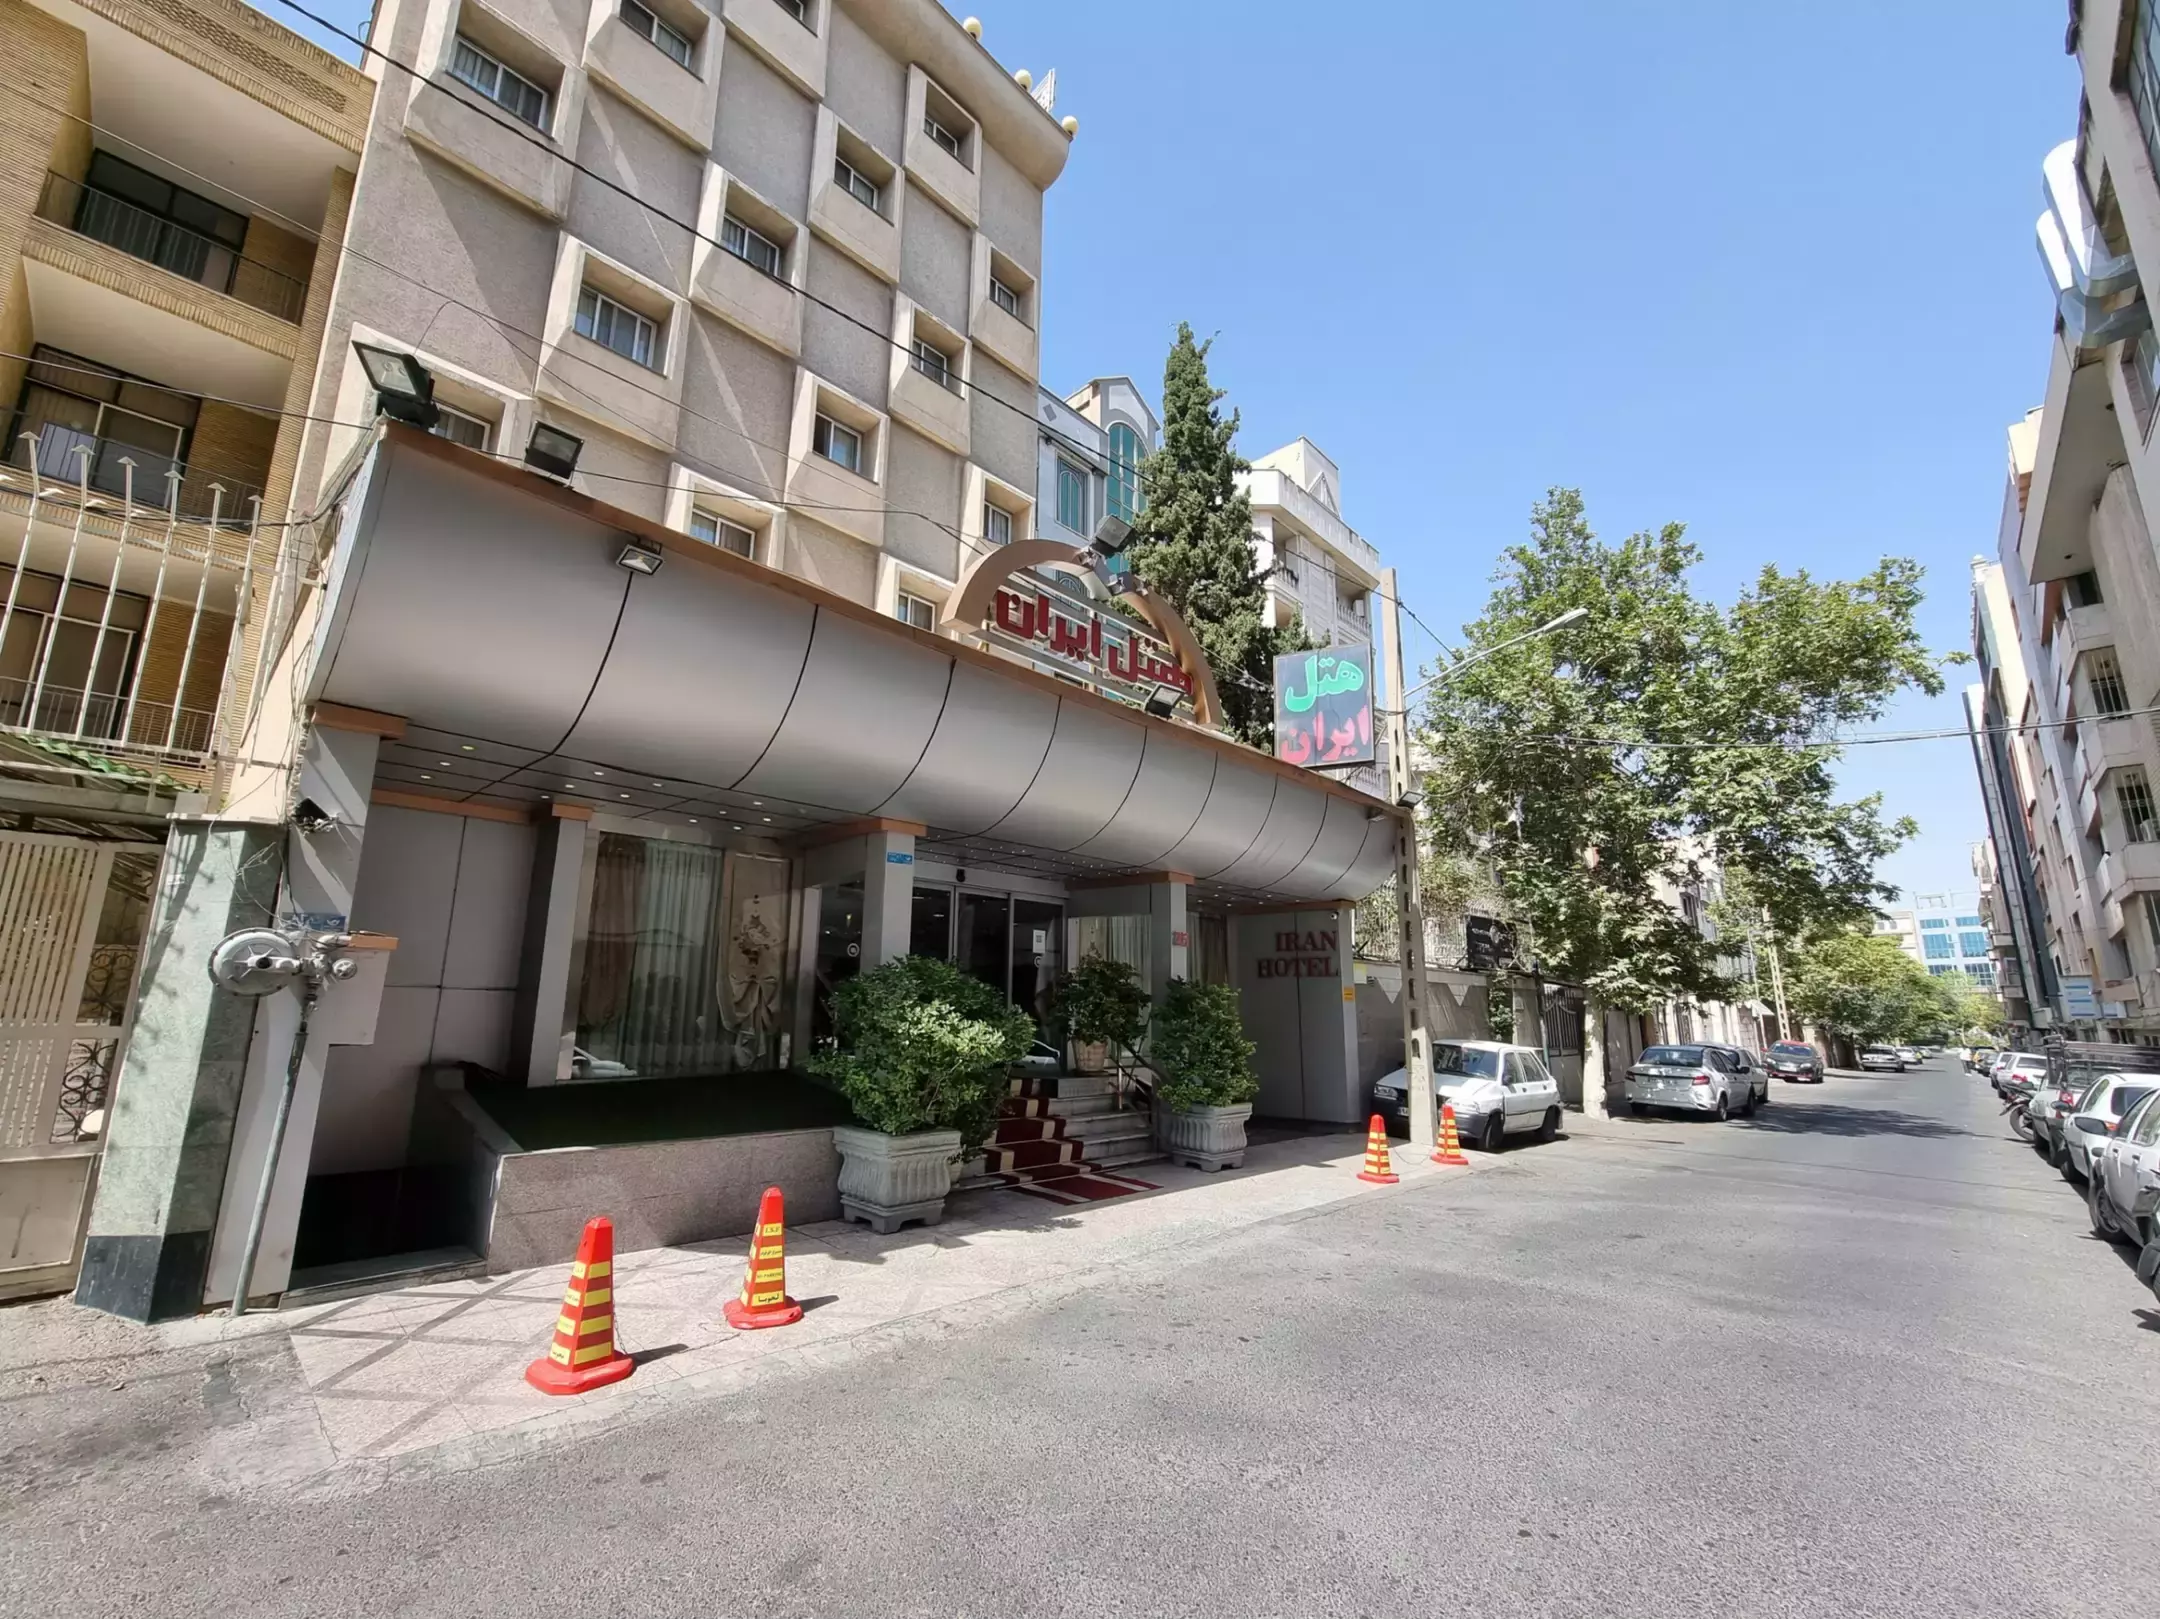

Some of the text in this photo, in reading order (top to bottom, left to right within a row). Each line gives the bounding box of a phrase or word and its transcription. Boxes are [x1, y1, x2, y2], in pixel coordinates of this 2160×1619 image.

[996, 588, 1193, 696] هتل ایران
[1285, 655, 1364, 712] هتل
[1281, 705, 1369, 764] ایران
[1257, 956, 1339, 978] HOTEL
[1275, 931, 1337, 951] IRAN
